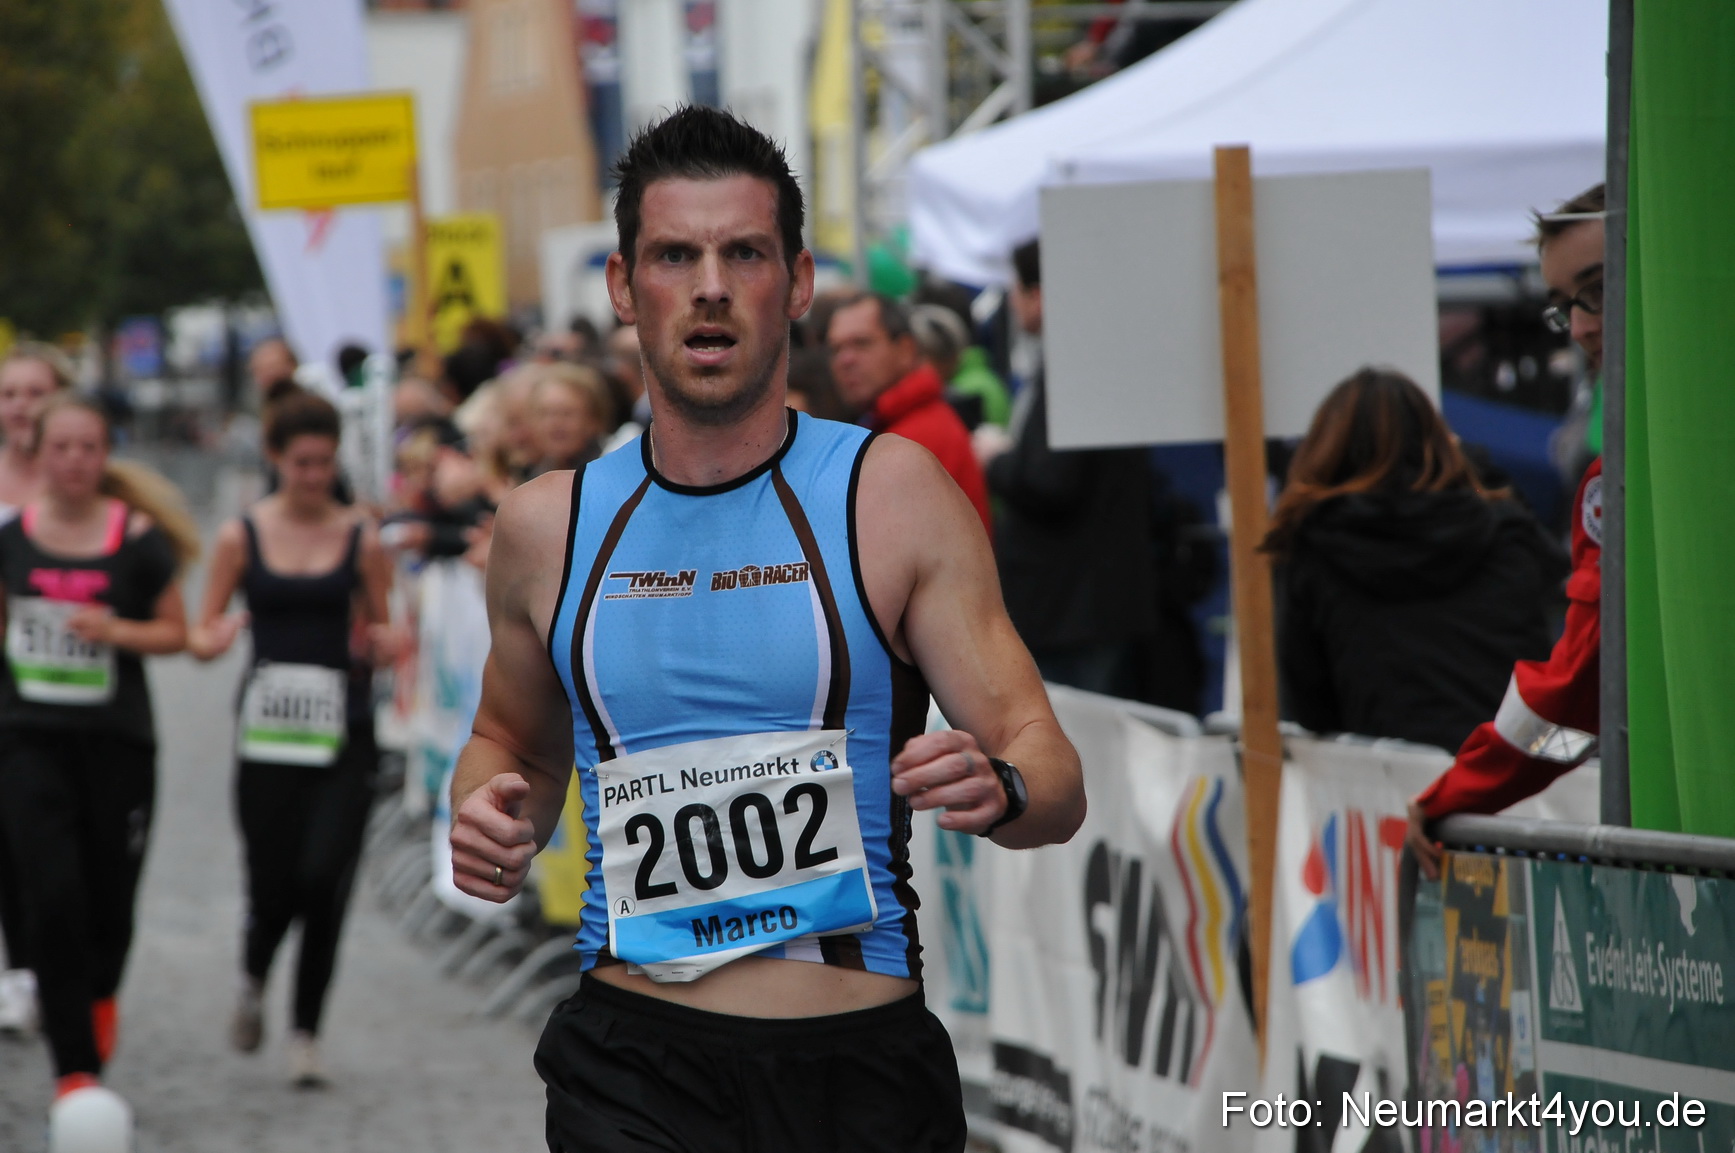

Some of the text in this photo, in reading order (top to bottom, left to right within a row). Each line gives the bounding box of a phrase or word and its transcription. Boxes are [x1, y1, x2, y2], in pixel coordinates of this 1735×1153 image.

[763, 561, 809, 585] RACER
[604, 757, 801, 808] PARTL Neumarkt
[624, 782, 839, 901] 2002
[691, 905, 799, 949] Marco
[1586, 932, 1725, 1015] Event-Leit-Systeme
